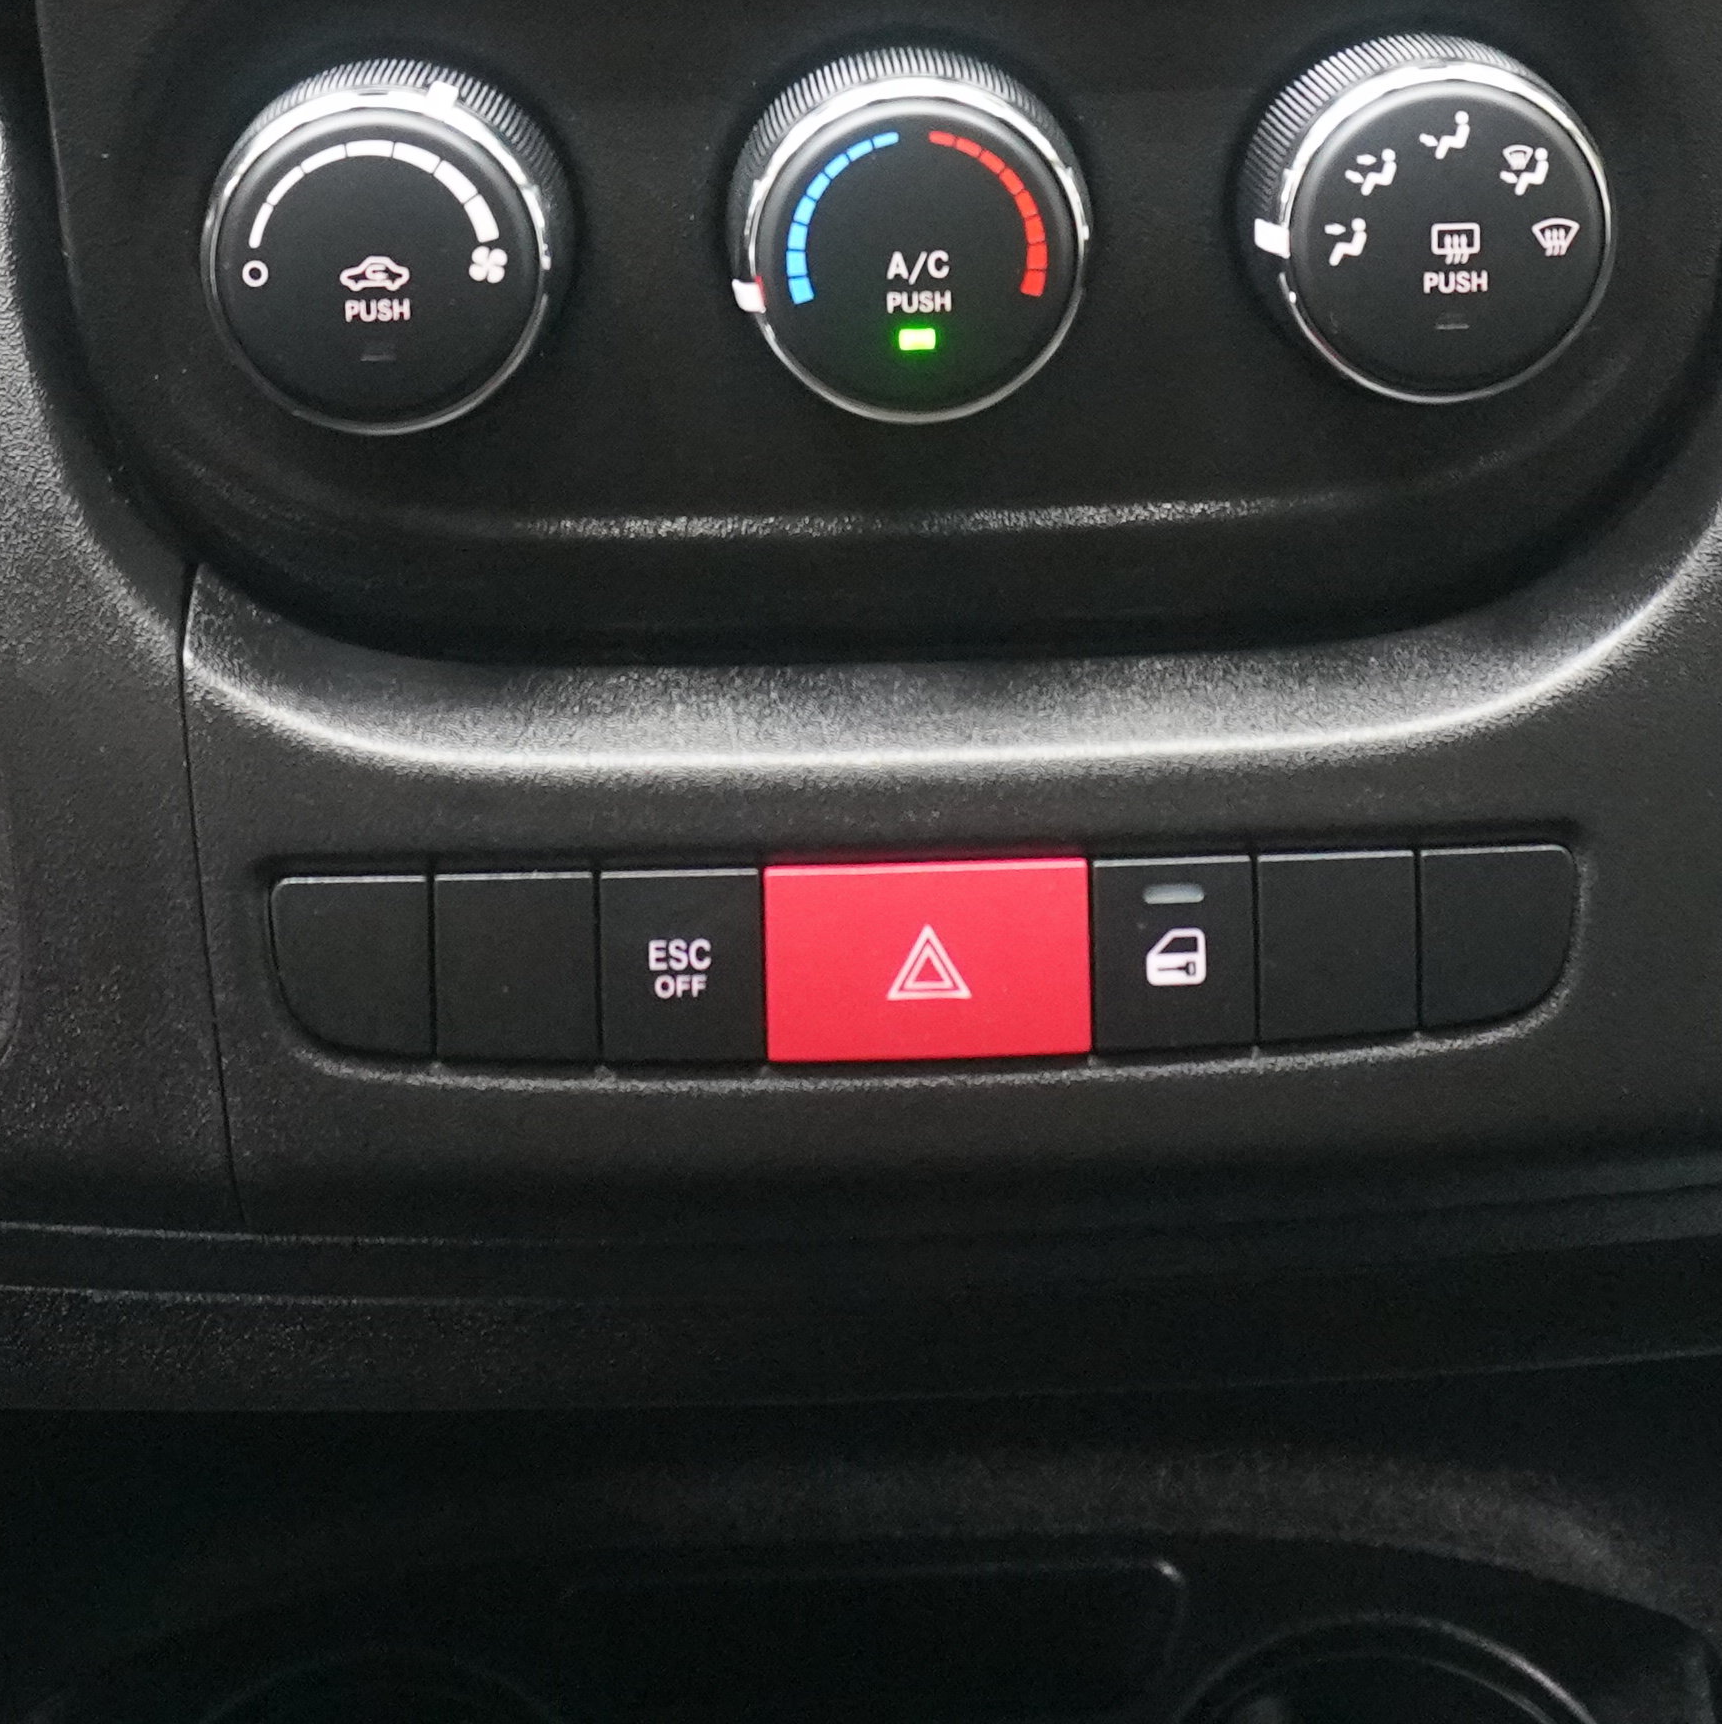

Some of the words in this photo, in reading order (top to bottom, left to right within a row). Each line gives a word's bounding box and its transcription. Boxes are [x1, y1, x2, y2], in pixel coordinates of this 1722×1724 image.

[887, 250, 949, 281] A/C
[1424, 271, 1487, 293] PUSH
[345, 299, 410, 322] PUSH
[887, 290, 951, 313] PUSH
[649, 939, 711, 971] ESC
[654, 974, 707, 999] OFF
